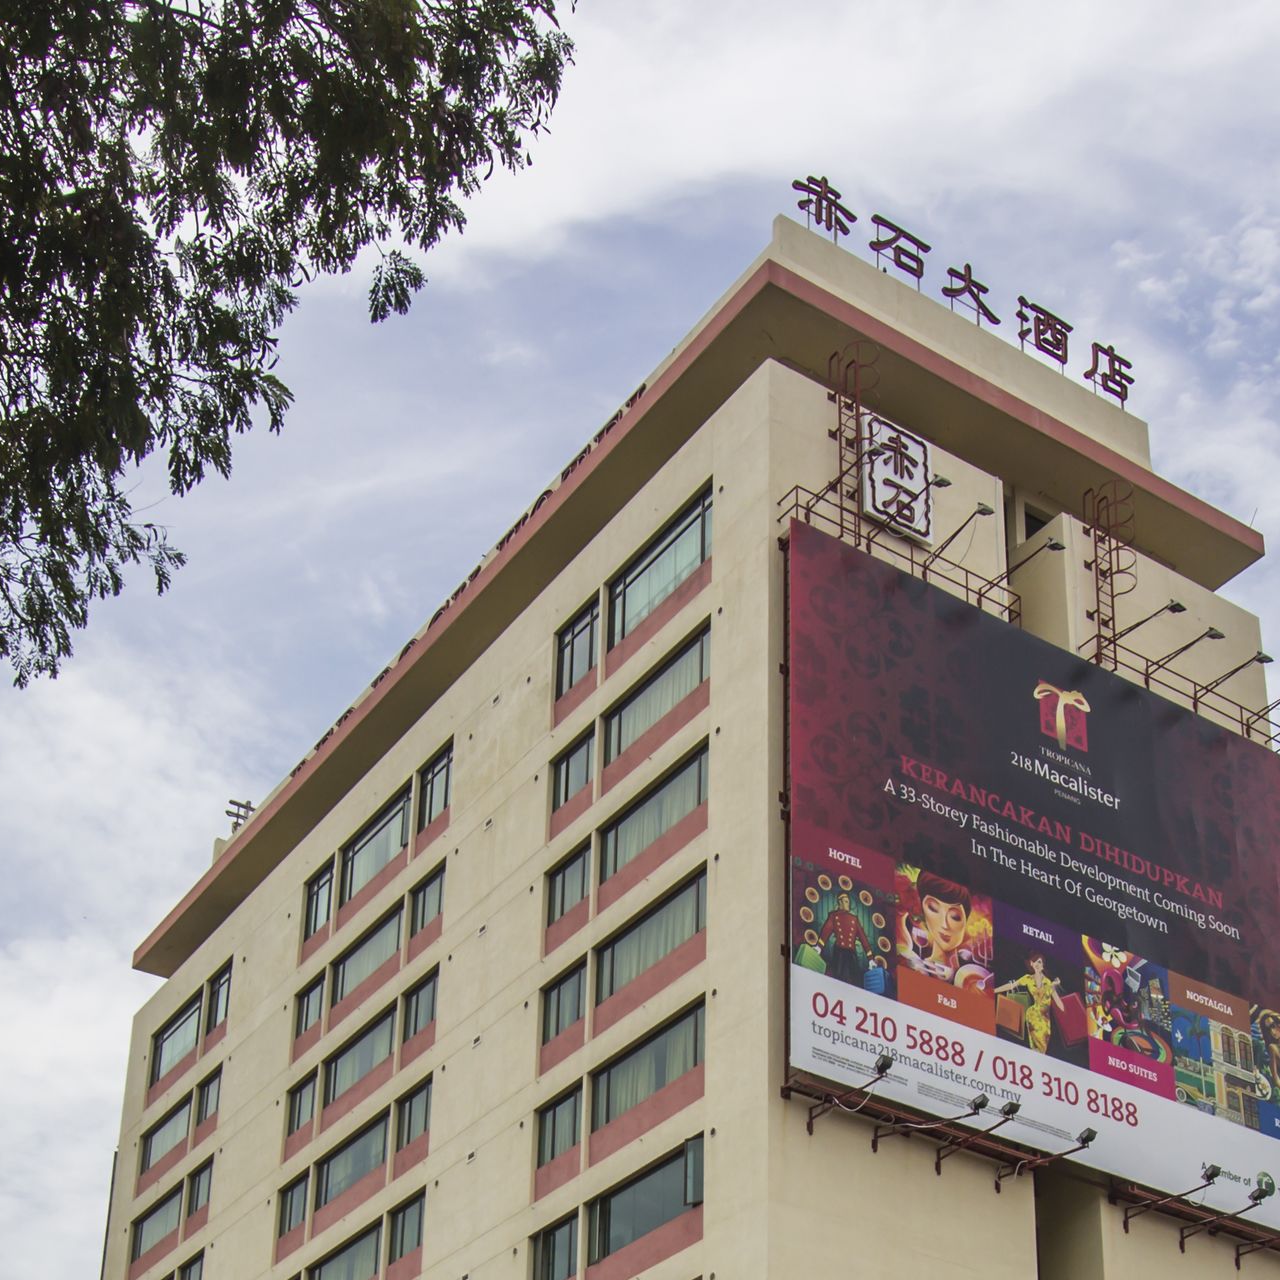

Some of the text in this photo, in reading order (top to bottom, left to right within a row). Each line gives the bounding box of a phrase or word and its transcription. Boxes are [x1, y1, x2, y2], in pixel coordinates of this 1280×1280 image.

[880, 434, 920, 524] 赤石
[1039, 745, 1092, 776] TROPICANA
[899, 754, 1224, 910] KERANCAKAN DIHIDUPKAN
[828, 847, 863, 869] HOTEL
[883, 778, 1240, 940] A 33-Storey Fashionable Development Coming Soon
[971, 838, 1169, 934] In The Heart Of Georgetown
[1022, 923, 1055, 945] RETAIL
[937, 993, 958, 1009] F&B
[1186, 990, 1234, 1016] NOSTALGIA
[812, 991, 847, 1026] 04
[855, 1006, 898, 1043] 210
[906, 1023, 966, 1068] 5888
[974, 1049, 984, 1072] /
[992, 1055, 1034, 1091] 018
[1041, 1071, 1080, 1106] 310
[1086, 1088, 1139, 1128] 8188
[1107, 1055, 1158, 1082] NEO SUITES
[1243, 1176, 1251, 1187] of
